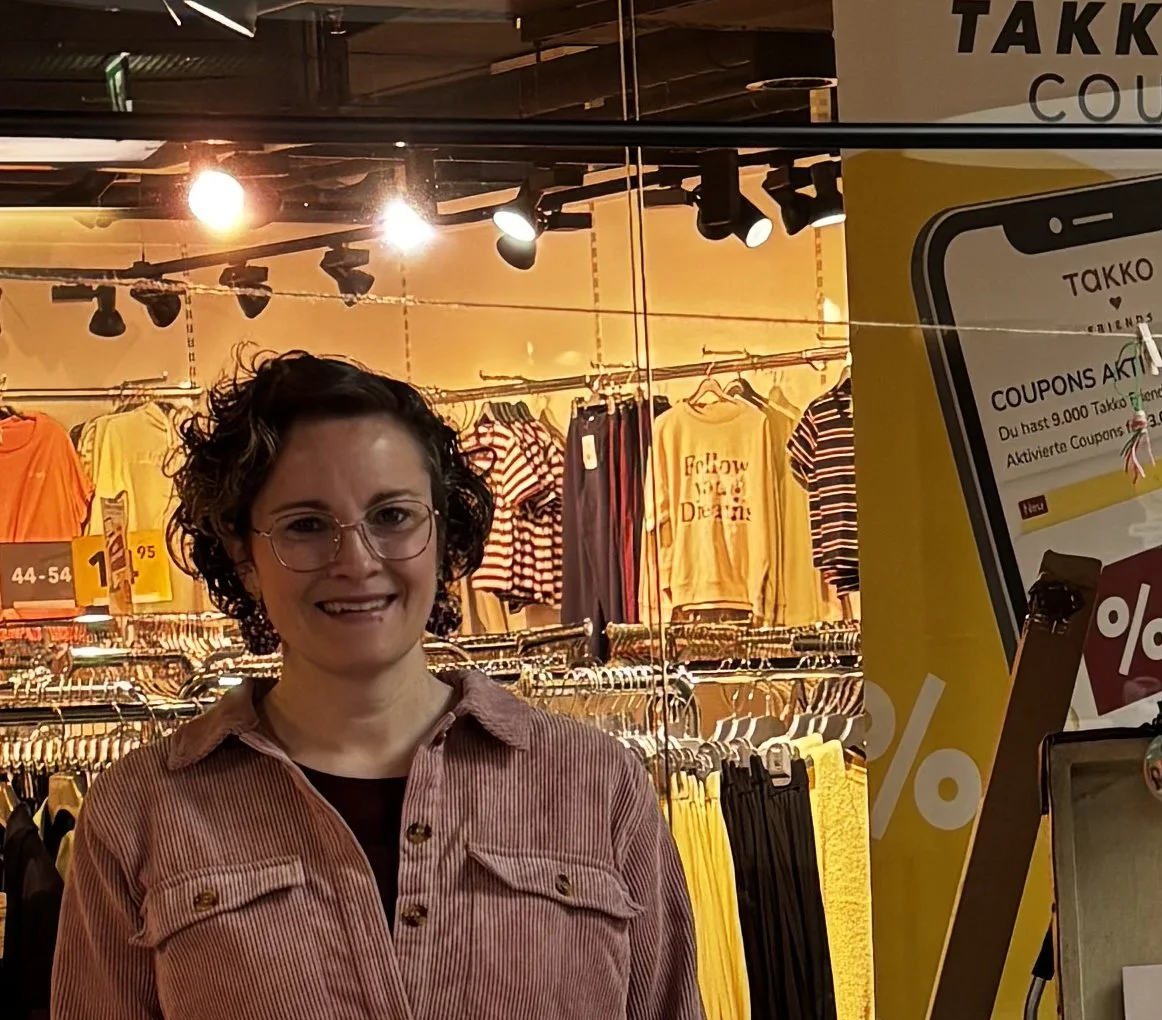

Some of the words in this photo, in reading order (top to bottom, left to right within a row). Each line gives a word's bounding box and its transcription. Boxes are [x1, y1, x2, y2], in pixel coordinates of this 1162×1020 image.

[991, 368, 1096, 412] COUPONS
[999, 426, 1018, 441] Du
[1020, 416, 1050, 435] hast
[1051, 405, 1089, 427] 9.000
[1091, 397, 1127, 415] Takko
[1007, 442, 1067, 468] Aktivierte
[1070, 426, 1124, 450] Coupons
[684, 452, 749, 476] Follow
[1023, 500, 1046, 516] Neu
[137, 545, 156, 559] 95
[12, 566, 72, 585] 44-54
